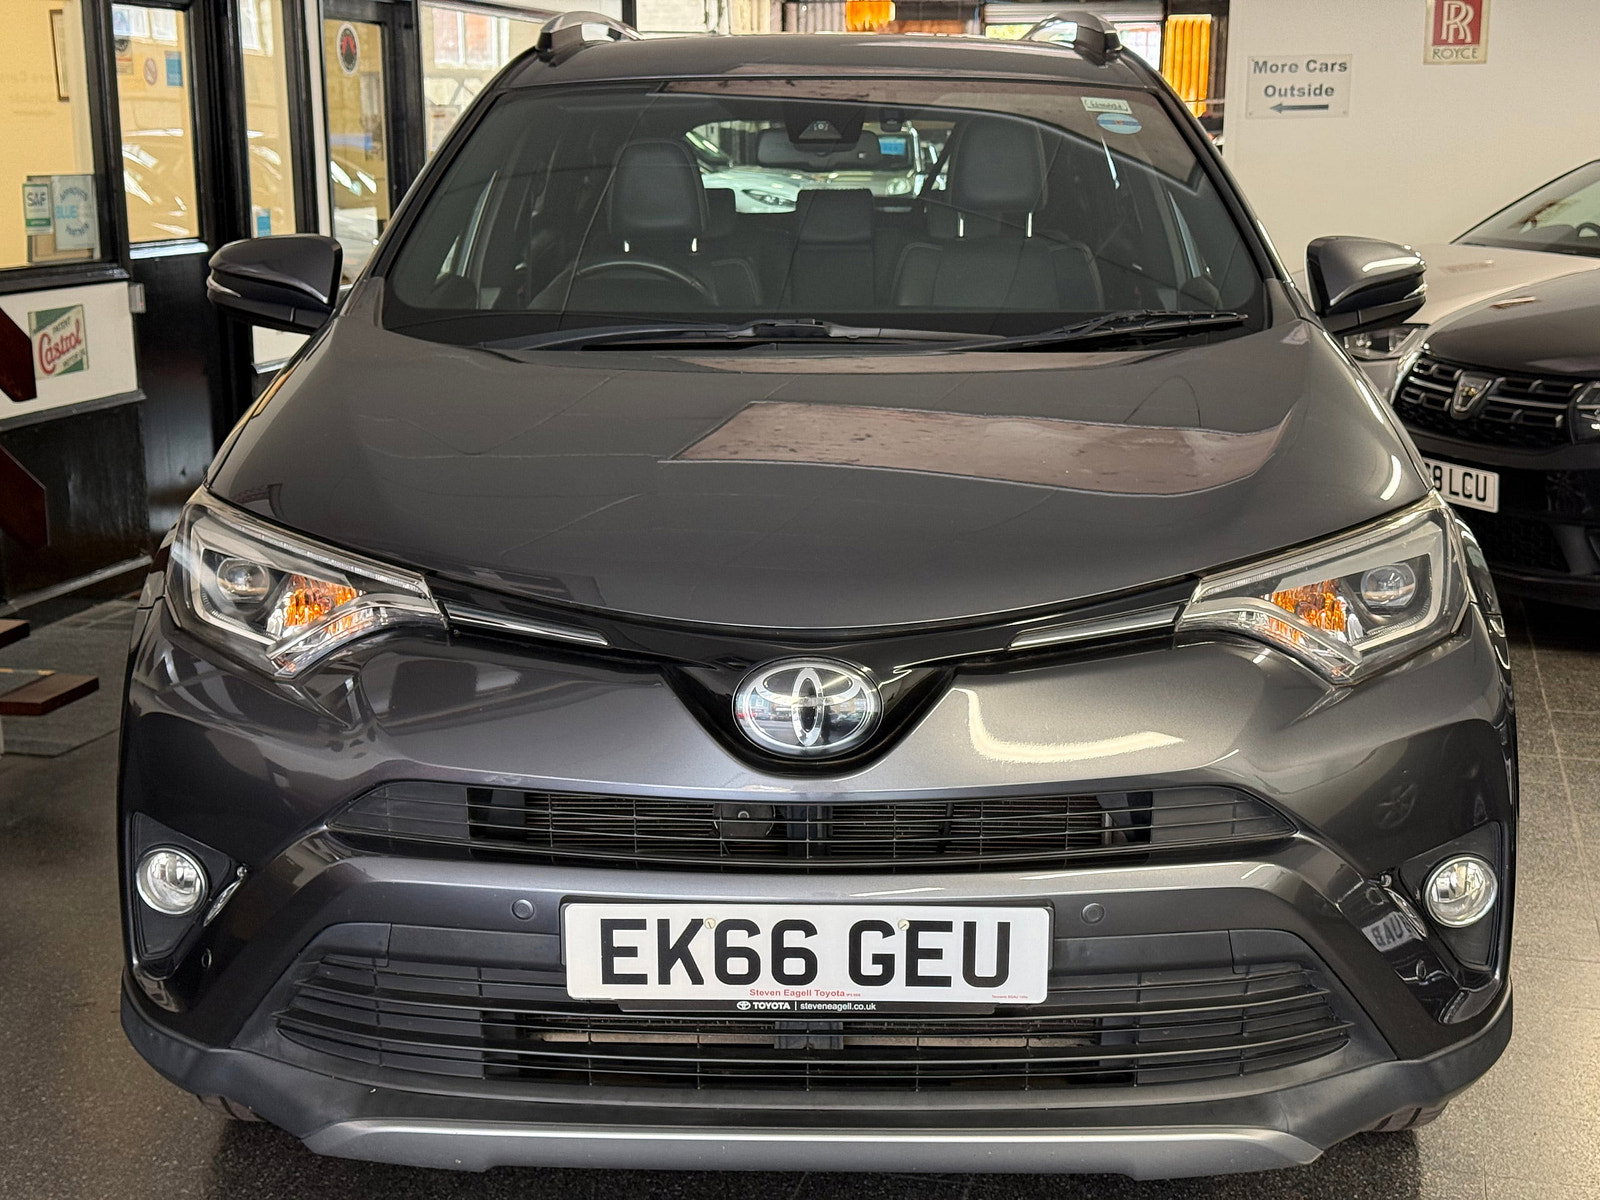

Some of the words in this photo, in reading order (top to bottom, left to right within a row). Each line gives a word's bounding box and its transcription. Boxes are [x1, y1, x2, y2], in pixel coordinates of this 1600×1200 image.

[1432, 48, 1479, 60] ROYCE
[1252, 59, 1299, 74] More
[1305, 59, 1348, 74] Cars
[1263, 83, 1335, 98] Outside
[39, 318, 82, 375] Castrol
[1425, 463, 1443, 492] 8
[1449, 468, 1487, 502] LCU
[600, 918, 818, 986] EK66
[848, 919, 1011, 988] GEU
[749, 989, 781, 997] Steven
[783, 989, 812, 998] Eagell
[814, 989, 845, 998] Toyota
[752, 1002, 791, 1010] TOYOTA
[800, 1002, 877, 1011] steveneagell.co.uk
